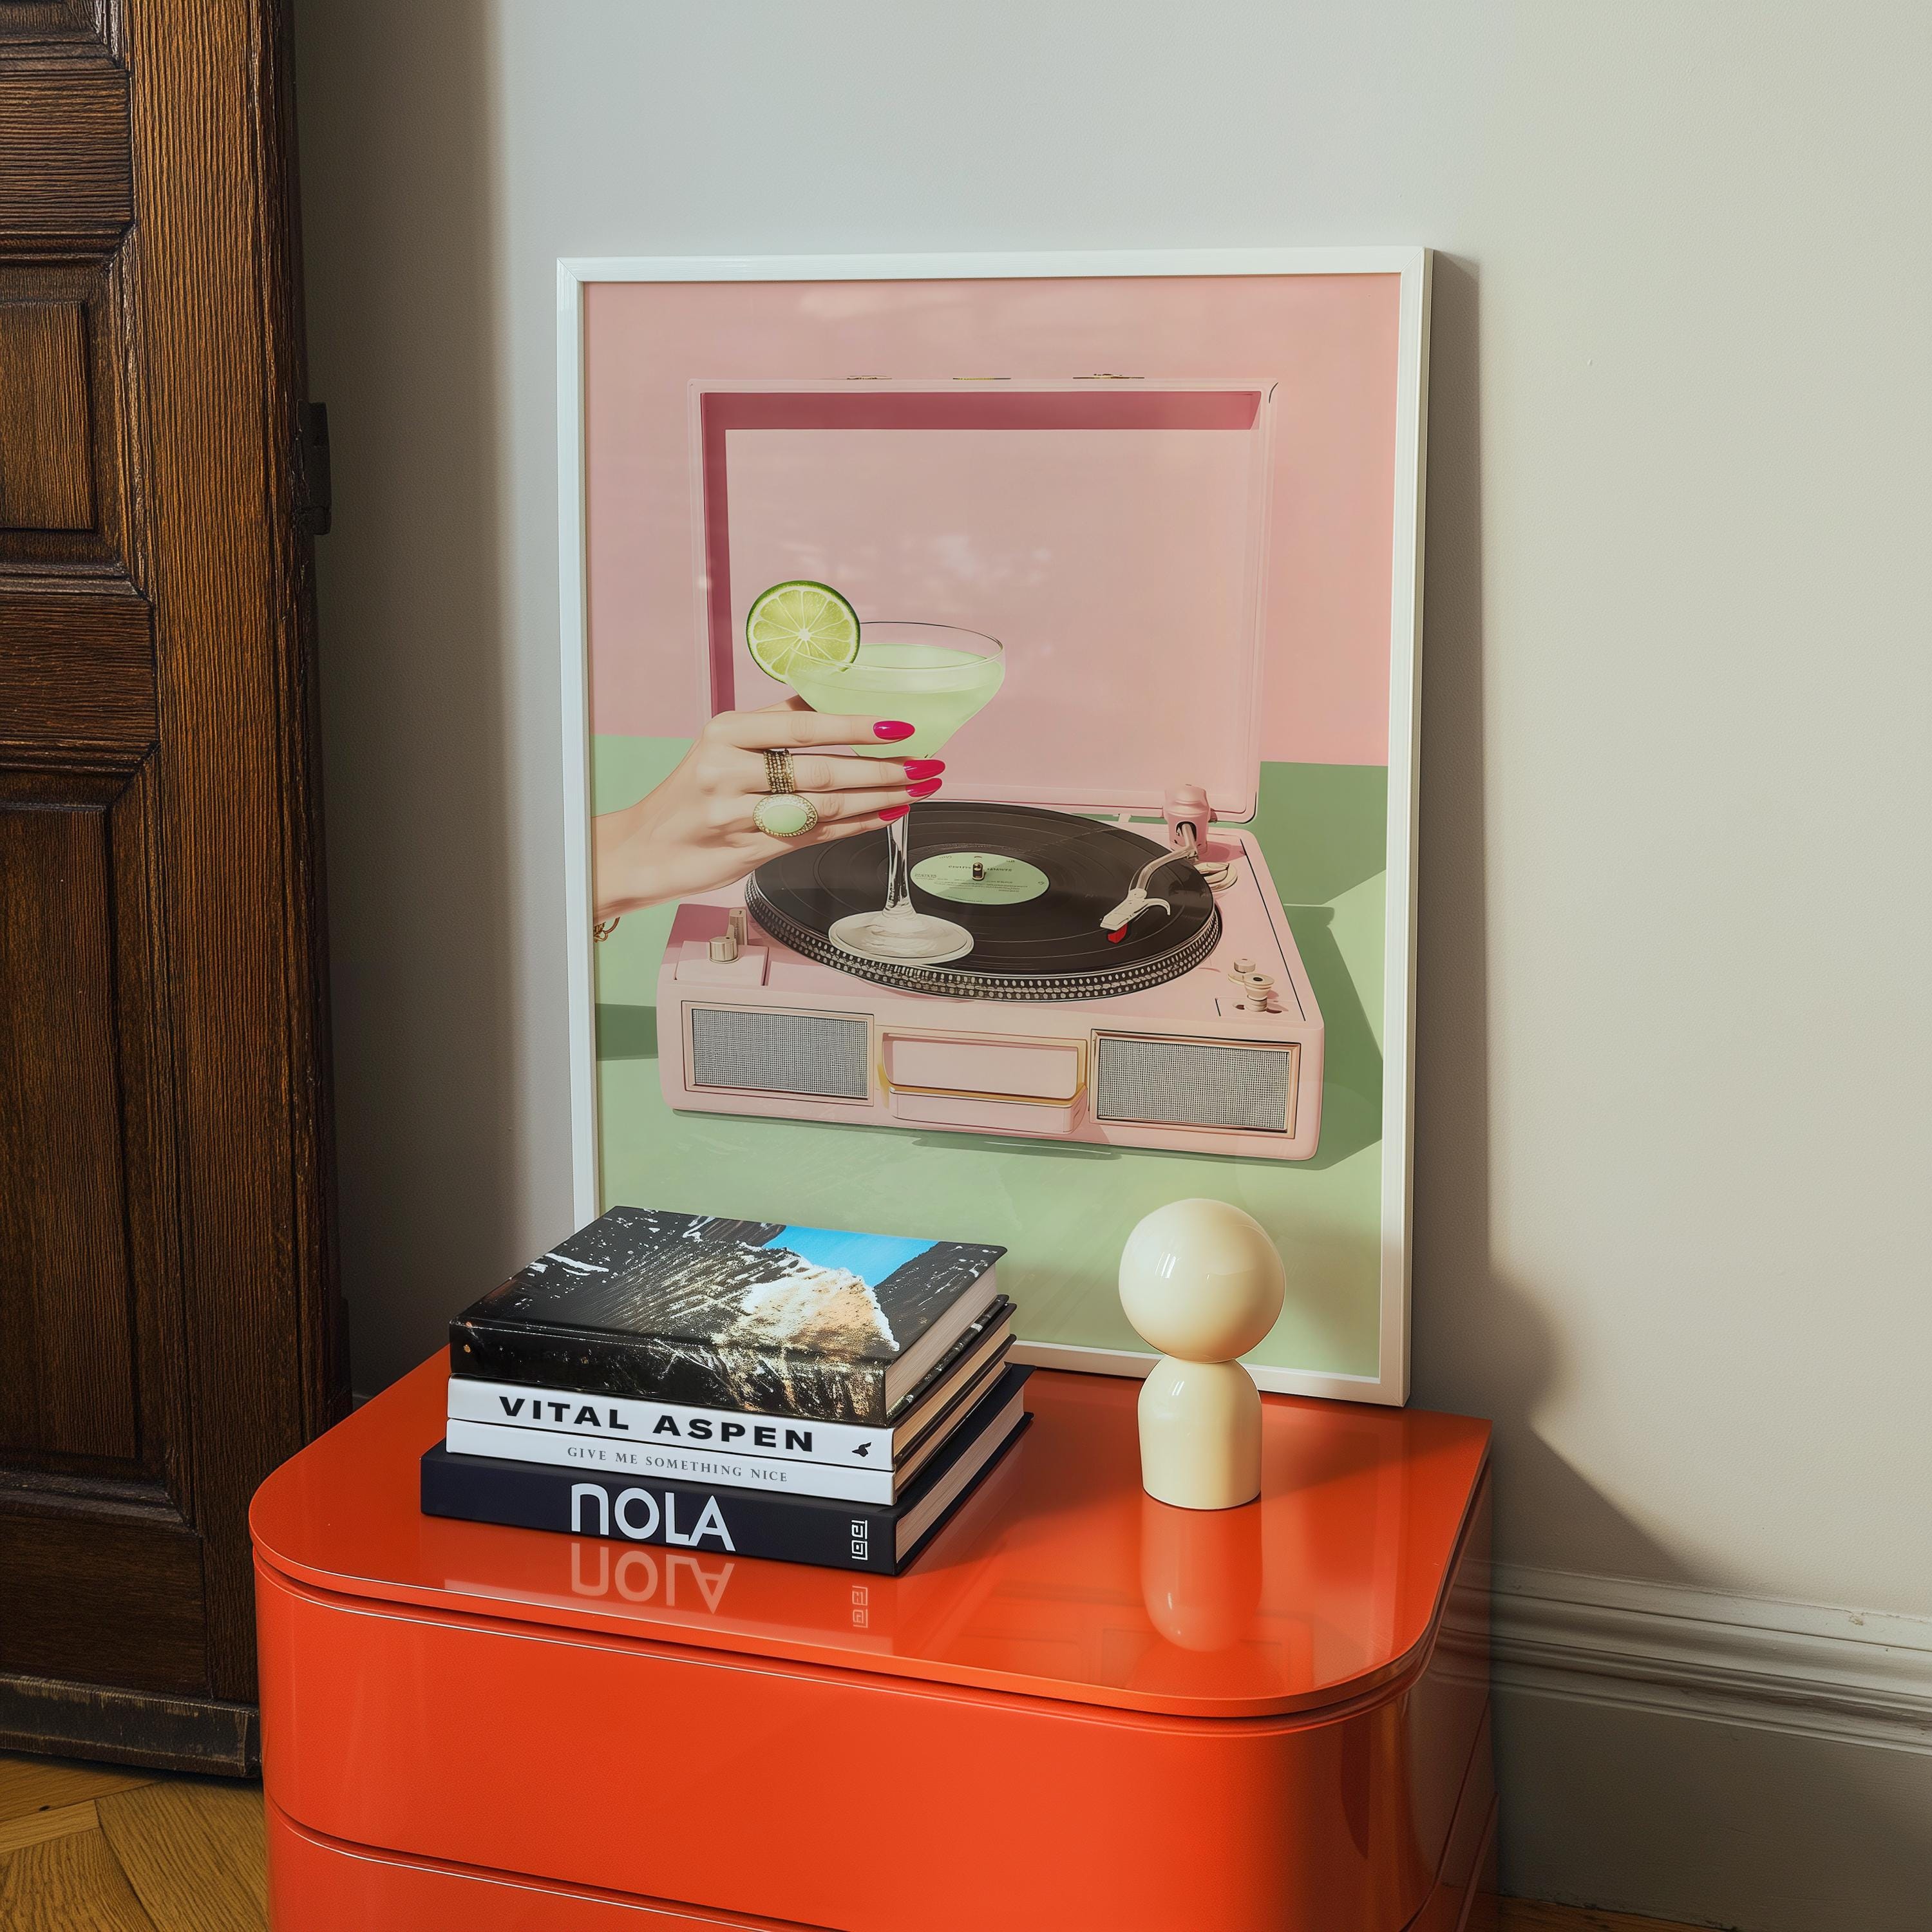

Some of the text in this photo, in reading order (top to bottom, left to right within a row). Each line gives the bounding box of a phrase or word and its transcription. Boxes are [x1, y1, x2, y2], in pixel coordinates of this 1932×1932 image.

[499, 1396, 812, 1452] VITAL ASPEN
[567, 1447, 787, 1482] GIVE ME SOMETHING NICE
